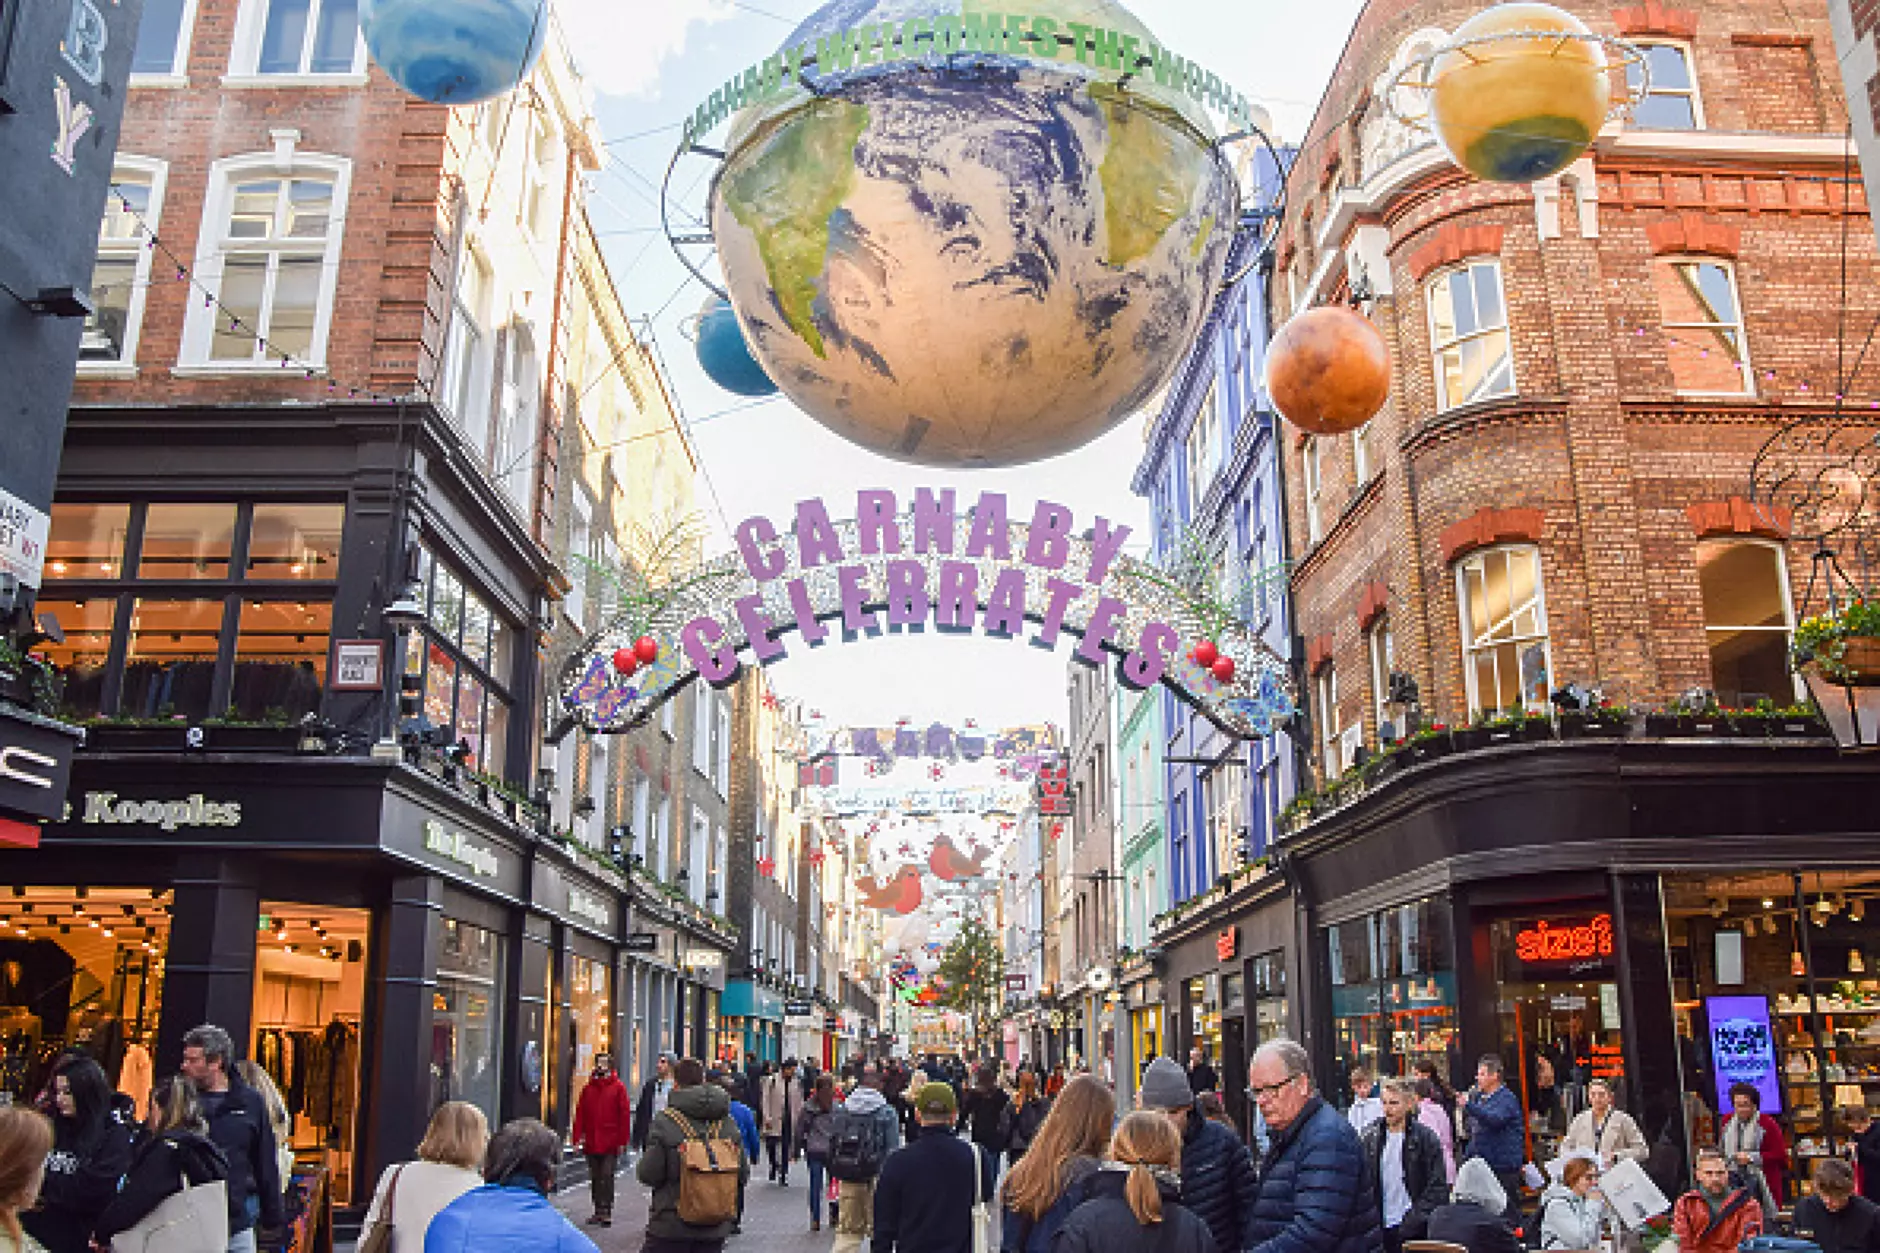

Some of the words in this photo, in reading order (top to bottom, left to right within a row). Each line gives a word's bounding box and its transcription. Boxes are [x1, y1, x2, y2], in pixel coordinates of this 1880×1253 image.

[681, 43, 806, 154] CARNABY
[815, 12, 1059, 75] WELCOMES
[1066, 21, 1143, 76] THE
[1148, 42, 1252, 134] WORLD
[735, 487, 1133, 583] CARNABY
[682, 559, 1179, 688] CELEBRATES
[82, 792, 242, 832] Kooples
[1515, 913, 1613, 960] size?
